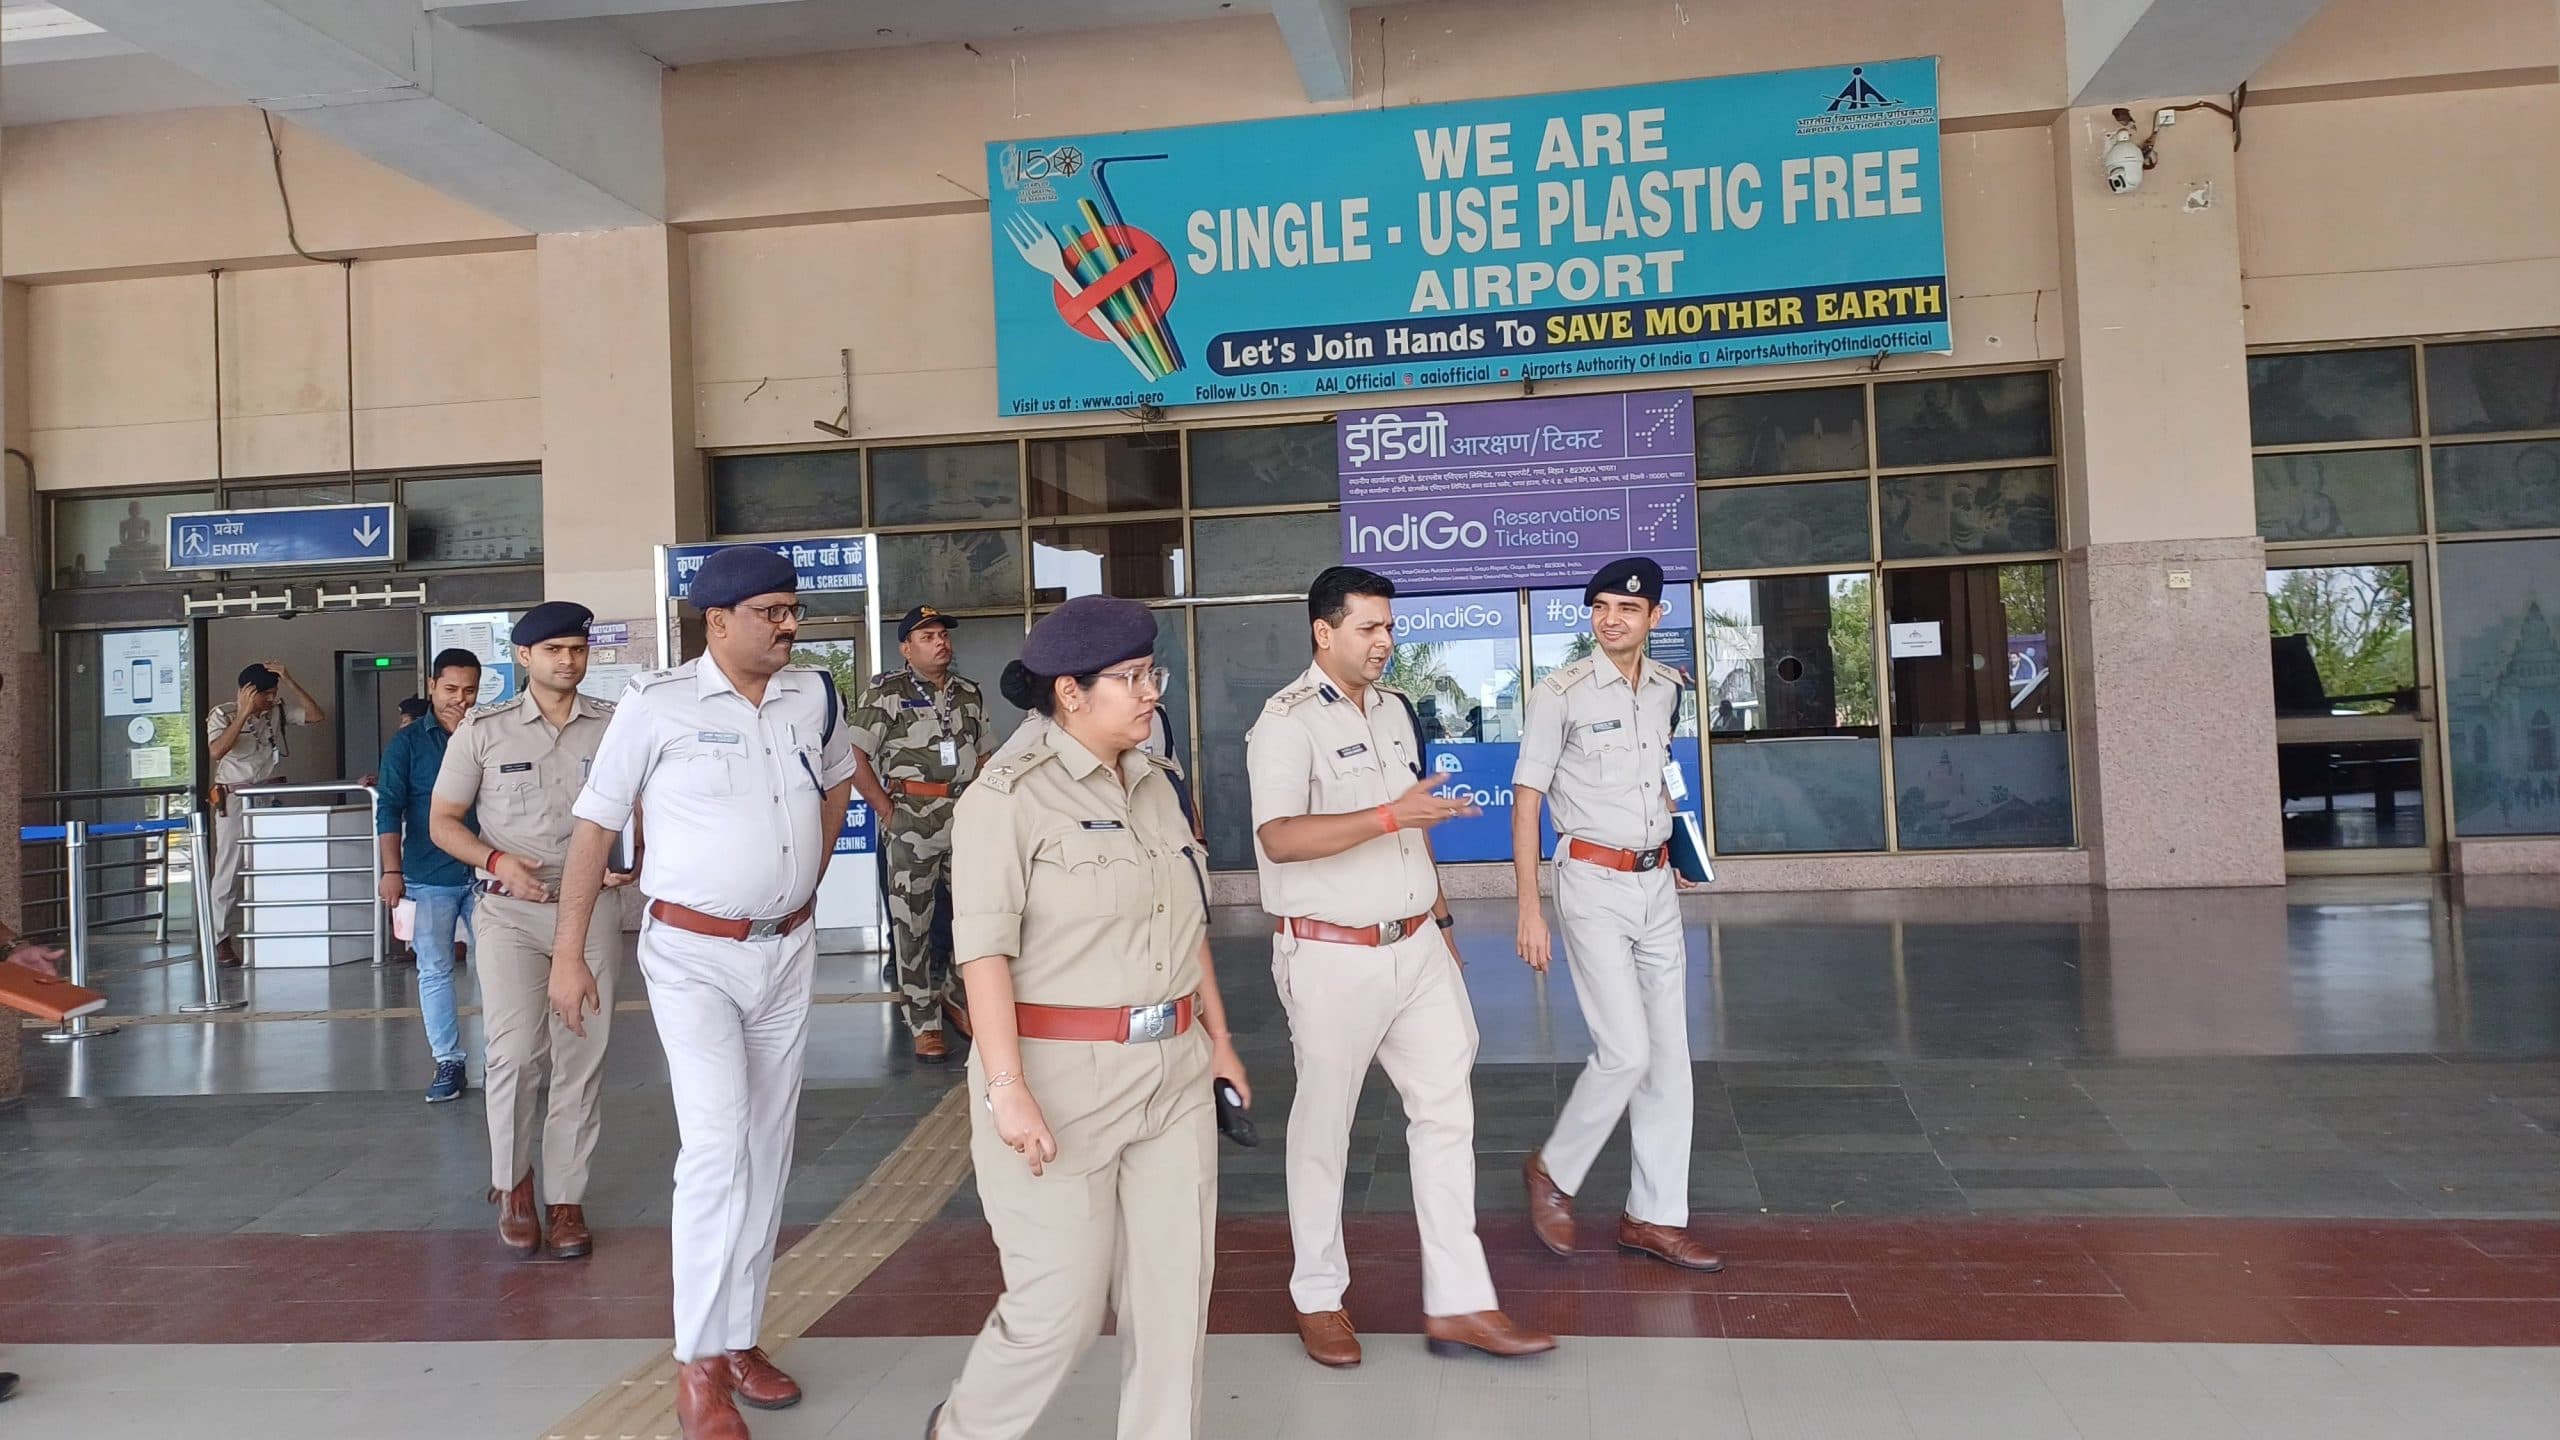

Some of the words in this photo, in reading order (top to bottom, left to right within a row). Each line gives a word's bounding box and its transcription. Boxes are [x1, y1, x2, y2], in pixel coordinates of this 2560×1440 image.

[1797, 125, 1841, 135] AIRPORTS
[1844, 121, 1894, 131] AUTHORITY
[1911, 117, 1935, 125] INDIA
[1414, 122, 1512, 181] WE
[1535, 108, 1668, 172] ARE
[1187, 197, 1372, 275] SINGLE
[1418, 184, 1521, 257] USE
[1537, 162, 1763, 247] PLASTIC
[1780, 148, 1922, 225] FREE
[1409, 249, 1685, 313] AIRPORT
[1222, 337, 1296, 370] Let's
[1306, 329, 1374, 364] Join
[1385, 322, 1485, 357] Hands
[1496, 318, 1537, 349] To
[1546, 308, 1633, 345] SAVE
[1645, 295, 1804, 337] MOTHER
[1816, 284, 1941, 327] EARTH
[1715, 330, 1933, 364] AirportsAuthorityOfIndiaOfficial
[1420, 365, 1491, 386] aaiofficial
[1521, 359, 1573, 380] Airports
[1576, 354, 1636, 374] Authority
[1639, 353, 1657, 369] Of
[1659, 351, 1692, 367] India
[1195, 384, 1238, 401] Follow
[1240, 382, 1258, 398] Us
[1260, 381, 1280, 396] On
[1315, 371, 1396, 394] AAI_Official
[1012, 398, 1039, 414] Visit
[1041, 400, 1056, 411] us
[1058, 397, 1073, 411] at
[1082, 389, 1164, 408] www.aai.aero
[1345, 411, 1449, 468] इंडिगो
[1450, 425, 1604, 457] आरक्षण/टिकट
[212, 518, 245, 536] प्रवेश
[1350, 510, 1488, 554] IndiGo
[1493, 506, 1621, 527] Reservations
[1494, 528, 1580, 549] Ticketing
[212, 542, 260, 557] ENTRY
[791, 544, 816, 568] लिए
[818, 543, 840, 566] यहाँ
[816, 573, 864, 589] SCREENING
[1392, 604, 1502, 637] goIndiGo
[834, 836, 866, 850] EENING
